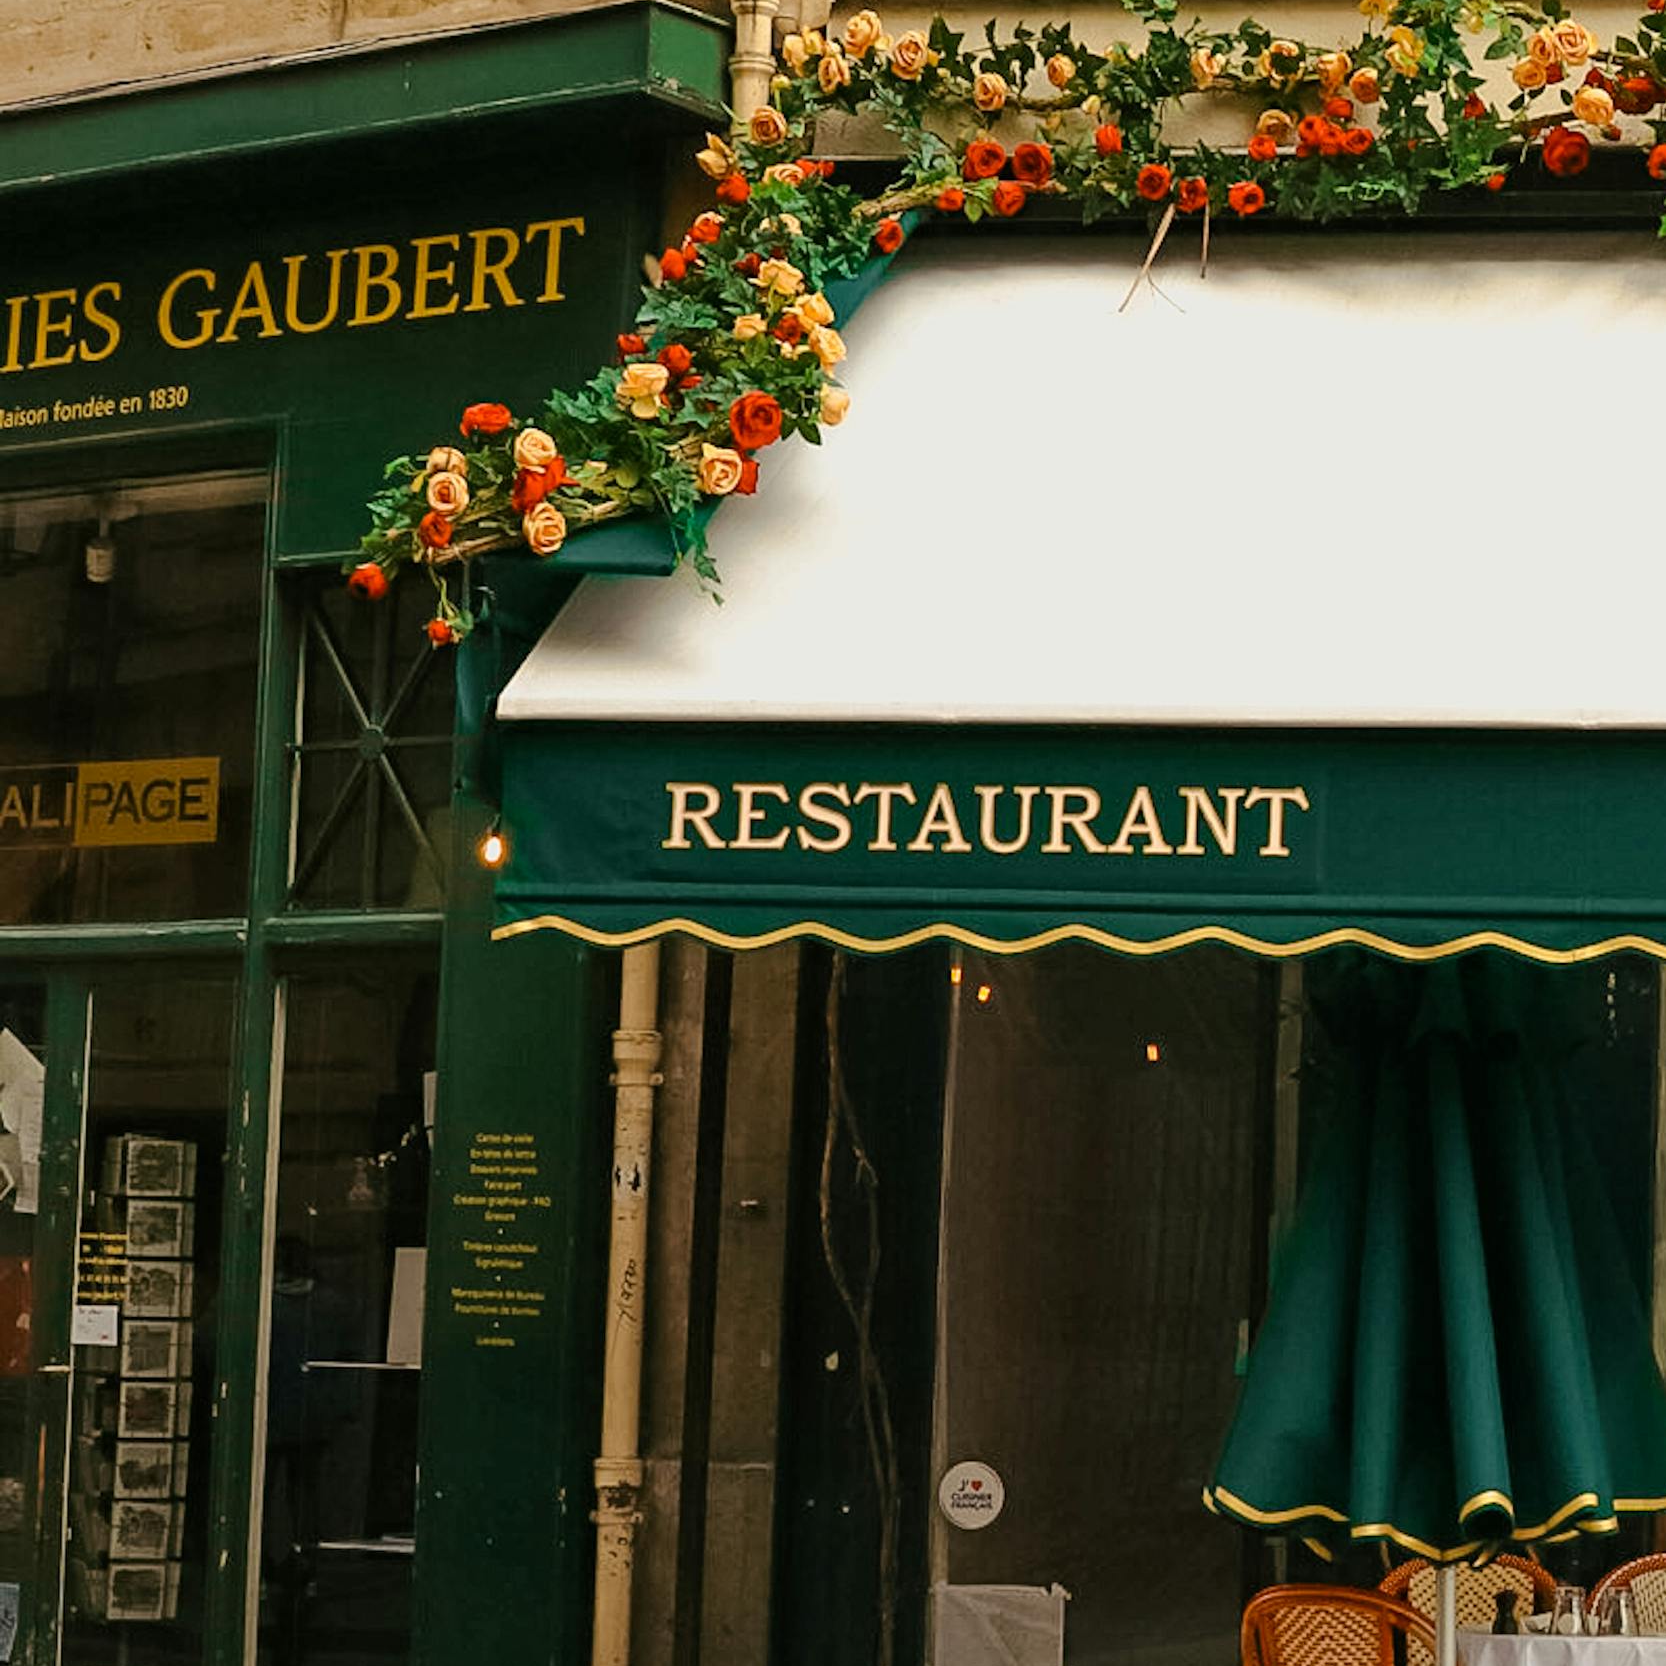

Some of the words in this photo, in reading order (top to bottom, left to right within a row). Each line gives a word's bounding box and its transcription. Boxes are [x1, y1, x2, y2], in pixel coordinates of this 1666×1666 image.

[157, 216, 585, 350] GAUBERT
[53, 395, 115, 422] fondée
[119, 396, 143, 414] en
[149, 386, 189, 411] 1830
[661, 781, 1310, 858] RESTAURANT
